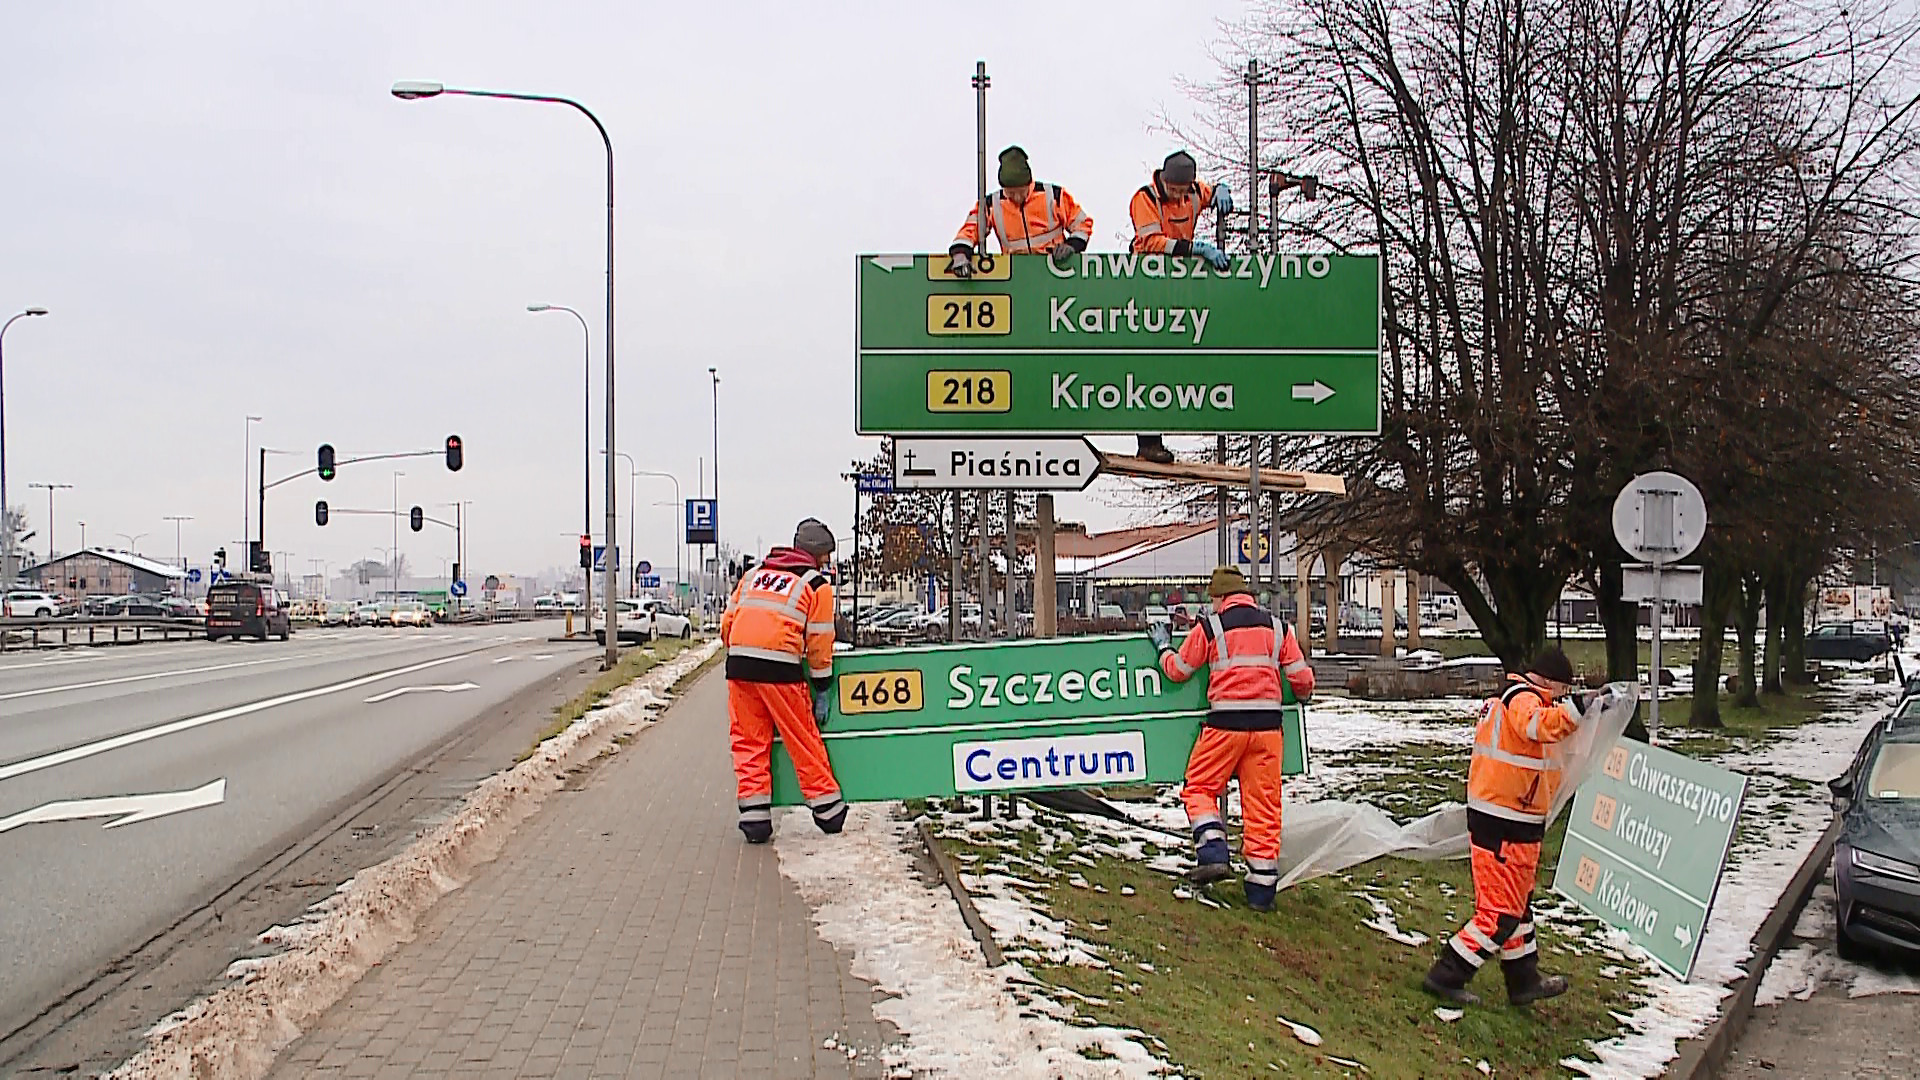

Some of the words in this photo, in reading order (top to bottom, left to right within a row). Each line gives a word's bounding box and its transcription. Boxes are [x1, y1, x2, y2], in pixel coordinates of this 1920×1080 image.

[942, 301, 996, 329] 218
[1050, 297, 1210, 344] Kartuzy
[942, 377, 996, 405] 218
[1051, 372, 1235, 410] Krokowa
[950, 450, 1082, 477] Piaśnica
[850, 678, 912, 707] 468
[947, 654, 1163, 709] Szczecin
[965, 746, 1136, 782] Centrum
[1628, 752, 1733, 825] Chwaszczyno
[1615, 802, 1672, 870] Kartuzy
[1597, 868, 1659, 937] Krokowa
